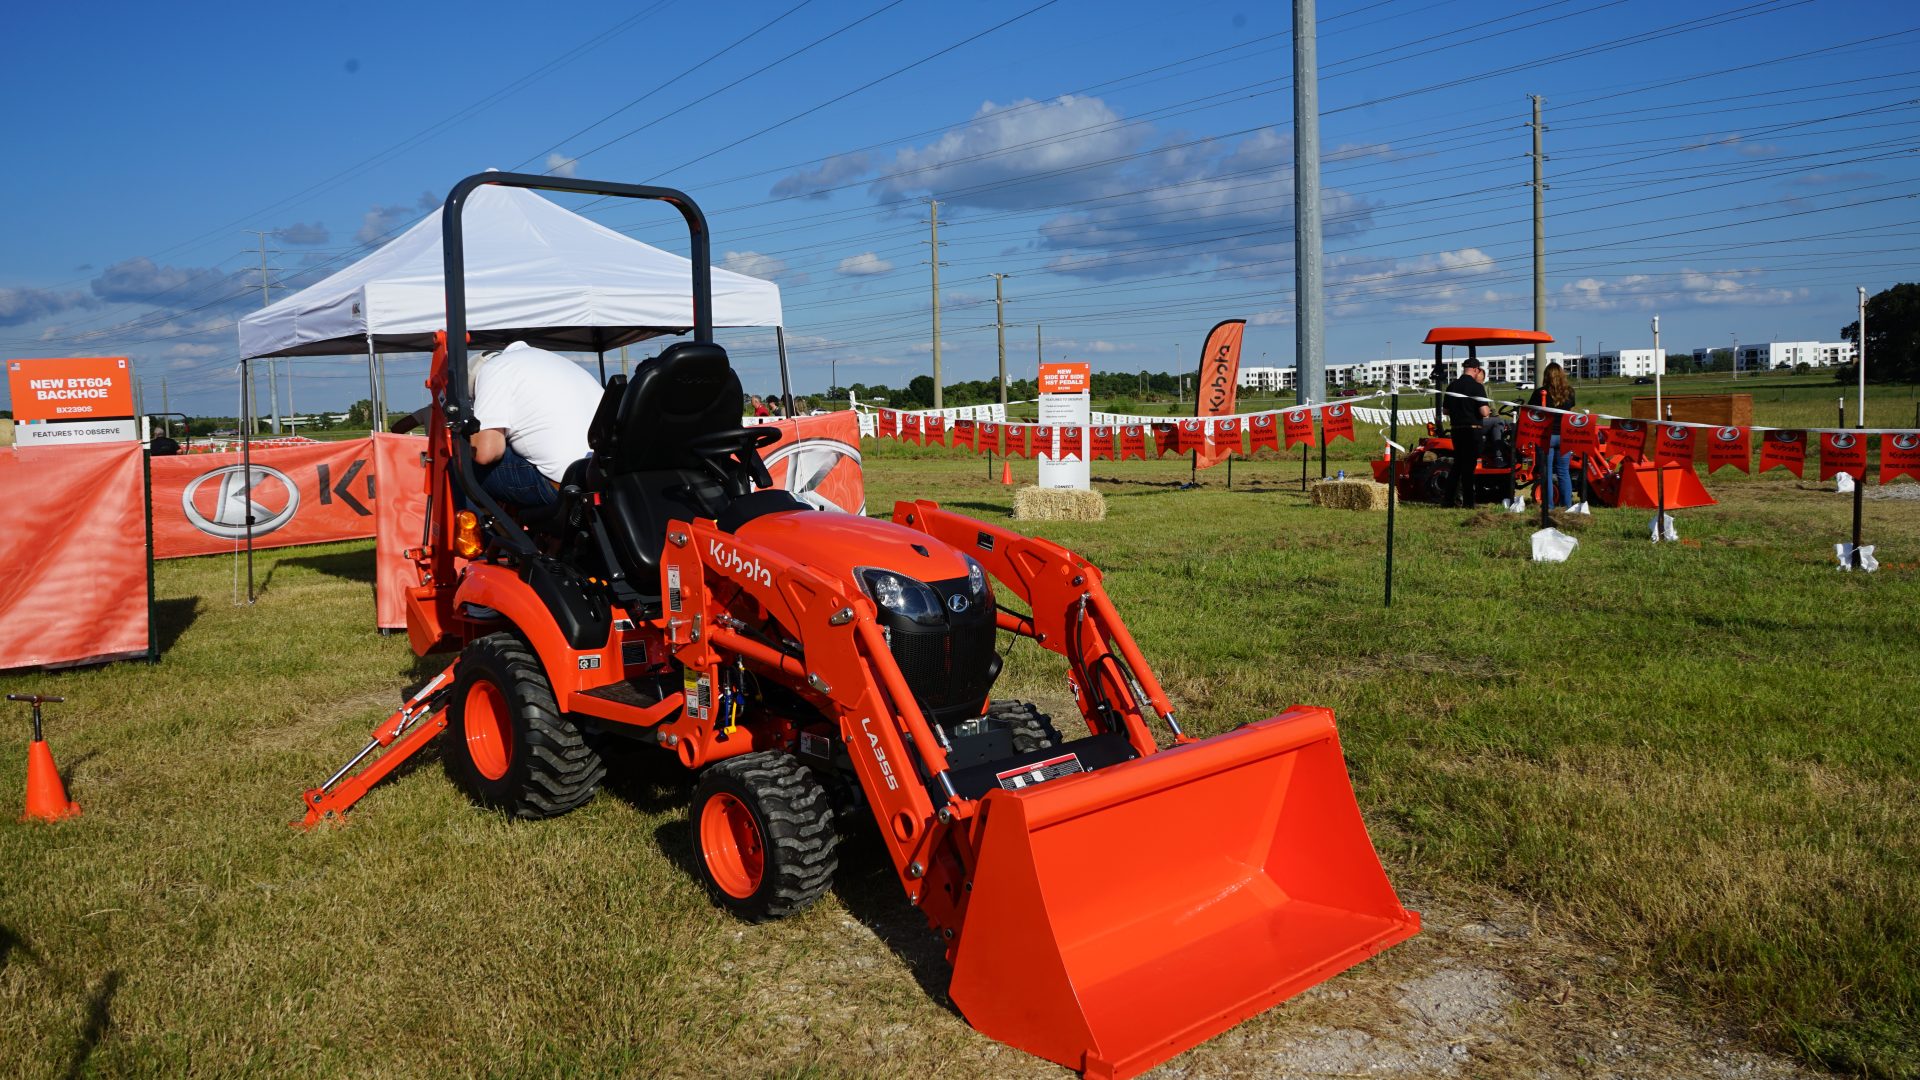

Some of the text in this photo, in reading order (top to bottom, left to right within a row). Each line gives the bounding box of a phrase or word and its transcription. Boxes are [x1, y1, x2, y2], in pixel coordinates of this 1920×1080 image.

[30, 377, 112, 389] NEW BT604
[1209, 345, 1230, 412] Kubota
[37, 388, 108, 400] BACKHOE
[32, 430, 72, 438] FEATURES
[85, 427, 120, 436] OBSERVE
[710, 538, 771, 587] Kubota
[861, 717, 899, 791] LA355
